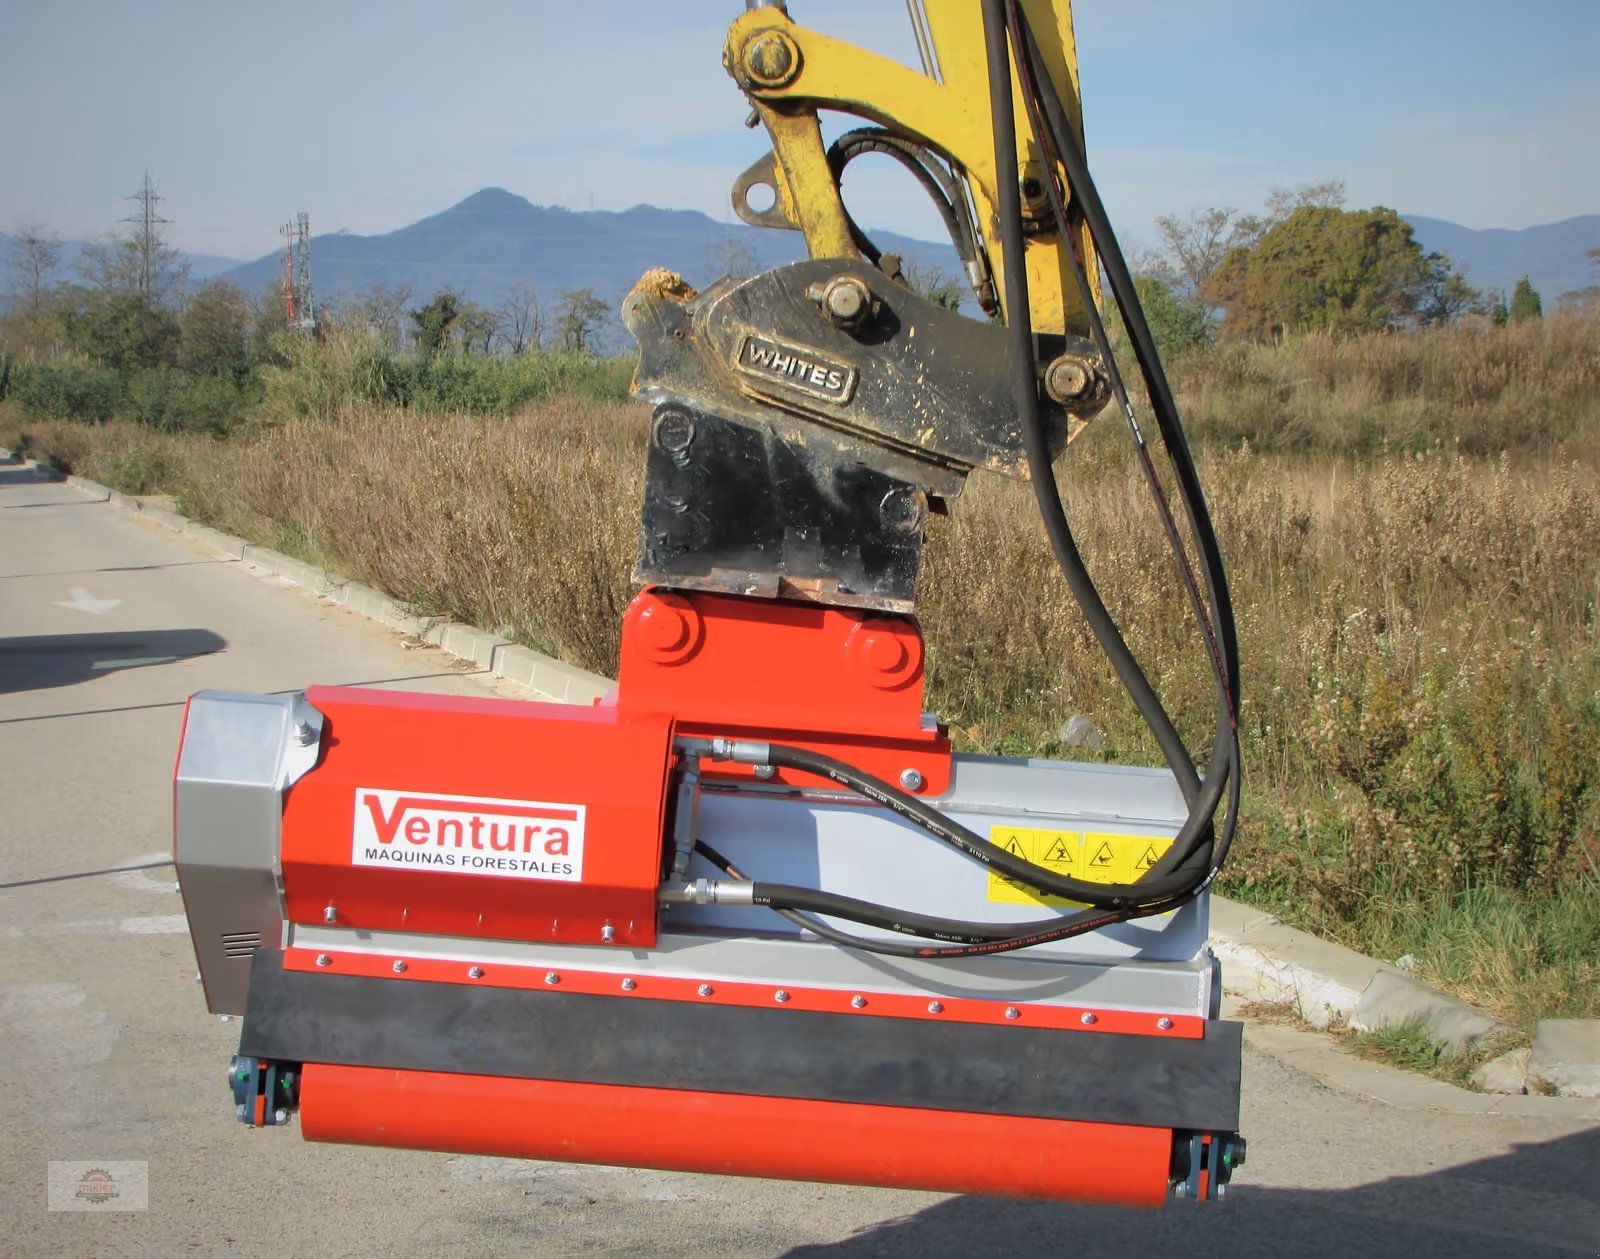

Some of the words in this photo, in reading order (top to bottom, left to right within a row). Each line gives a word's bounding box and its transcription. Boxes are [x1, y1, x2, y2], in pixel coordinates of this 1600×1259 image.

[750, 344, 843, 390] WHITES
[364, 794, 577, 856] Ventura
[461, 855, 573, 875] FORESTALES
